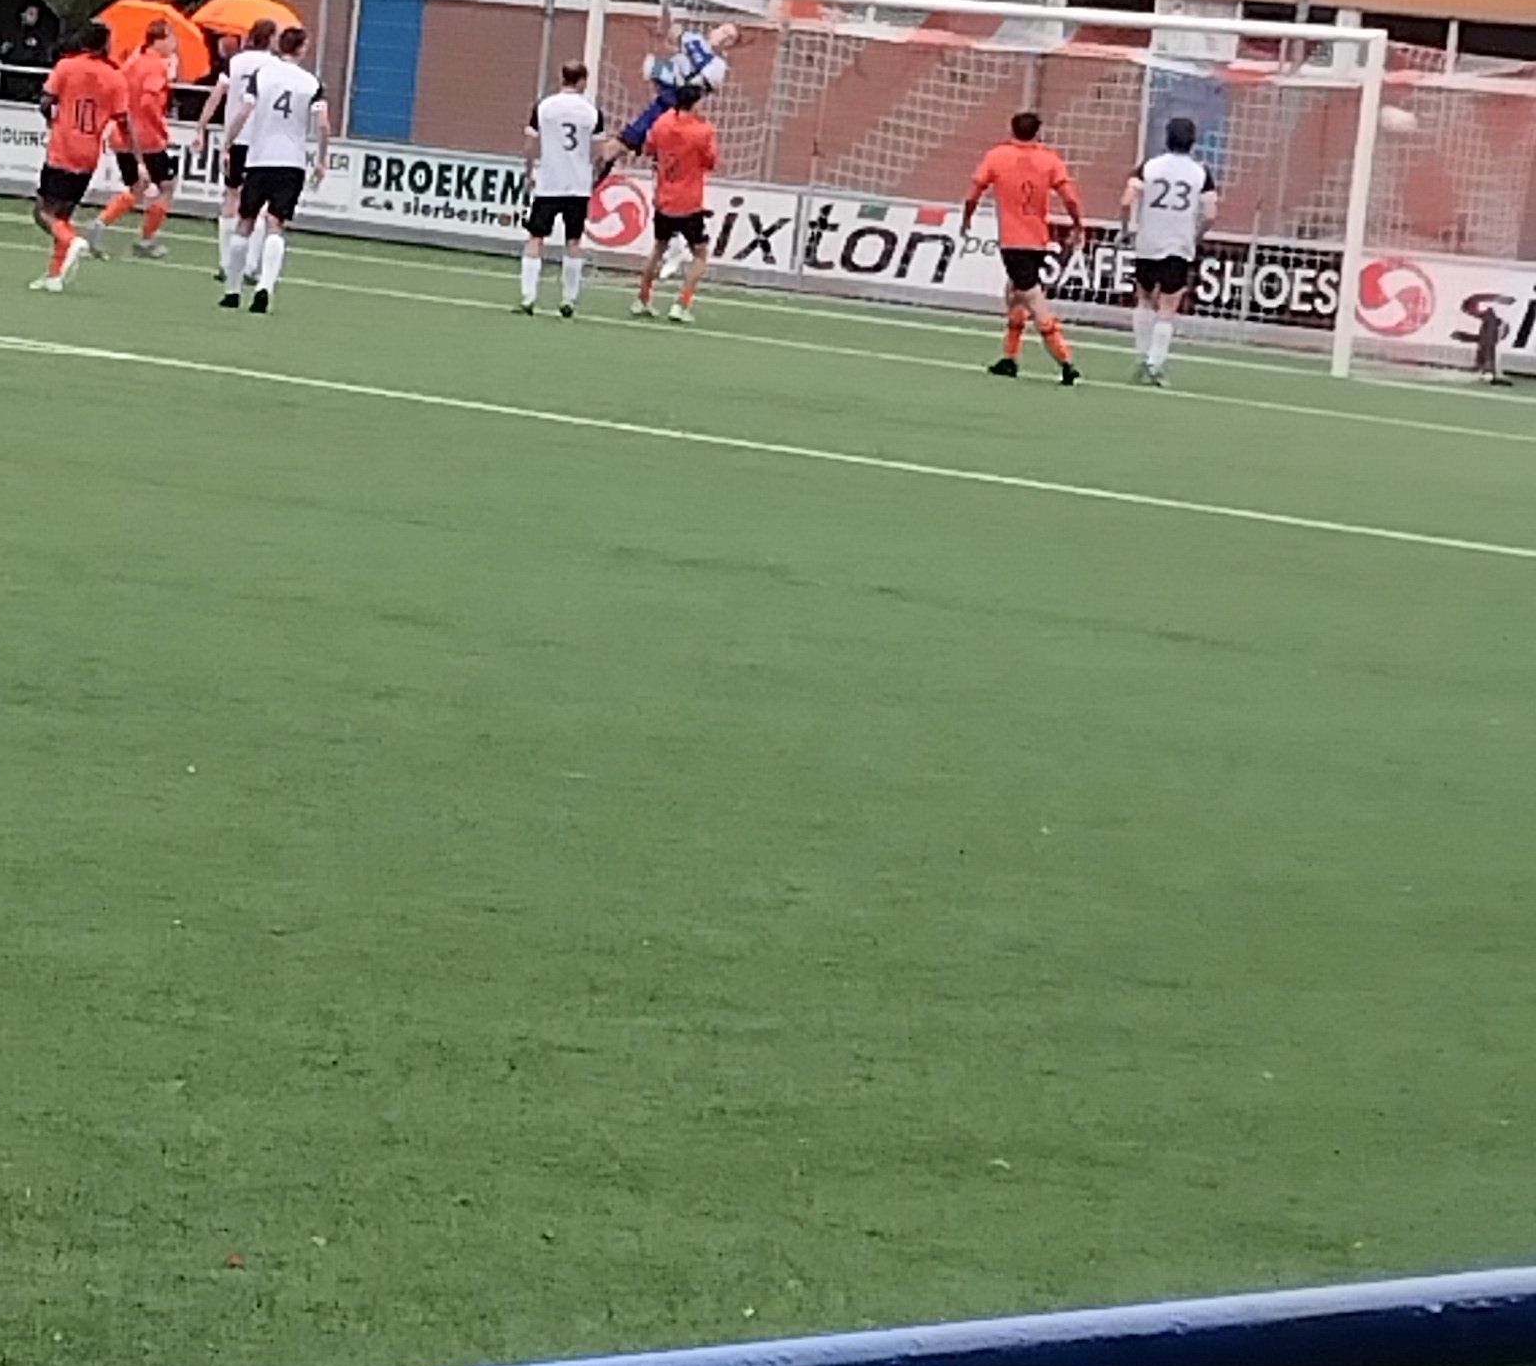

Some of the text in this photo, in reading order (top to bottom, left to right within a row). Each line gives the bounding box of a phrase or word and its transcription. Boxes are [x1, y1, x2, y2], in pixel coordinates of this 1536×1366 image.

[75, 98, 97, 135] 10
[272, 90, 293, 119] 4
[560, 122, 579, 152] 3
[361, 153, 531, 207] BROEKEM
[1149, 178, 1192, 211] 23
[714, 195, 999, 285] ixton pe
[1038, 241, 1340, 314] SAFE SHOES
[1450, 284, 1536, 349] si
